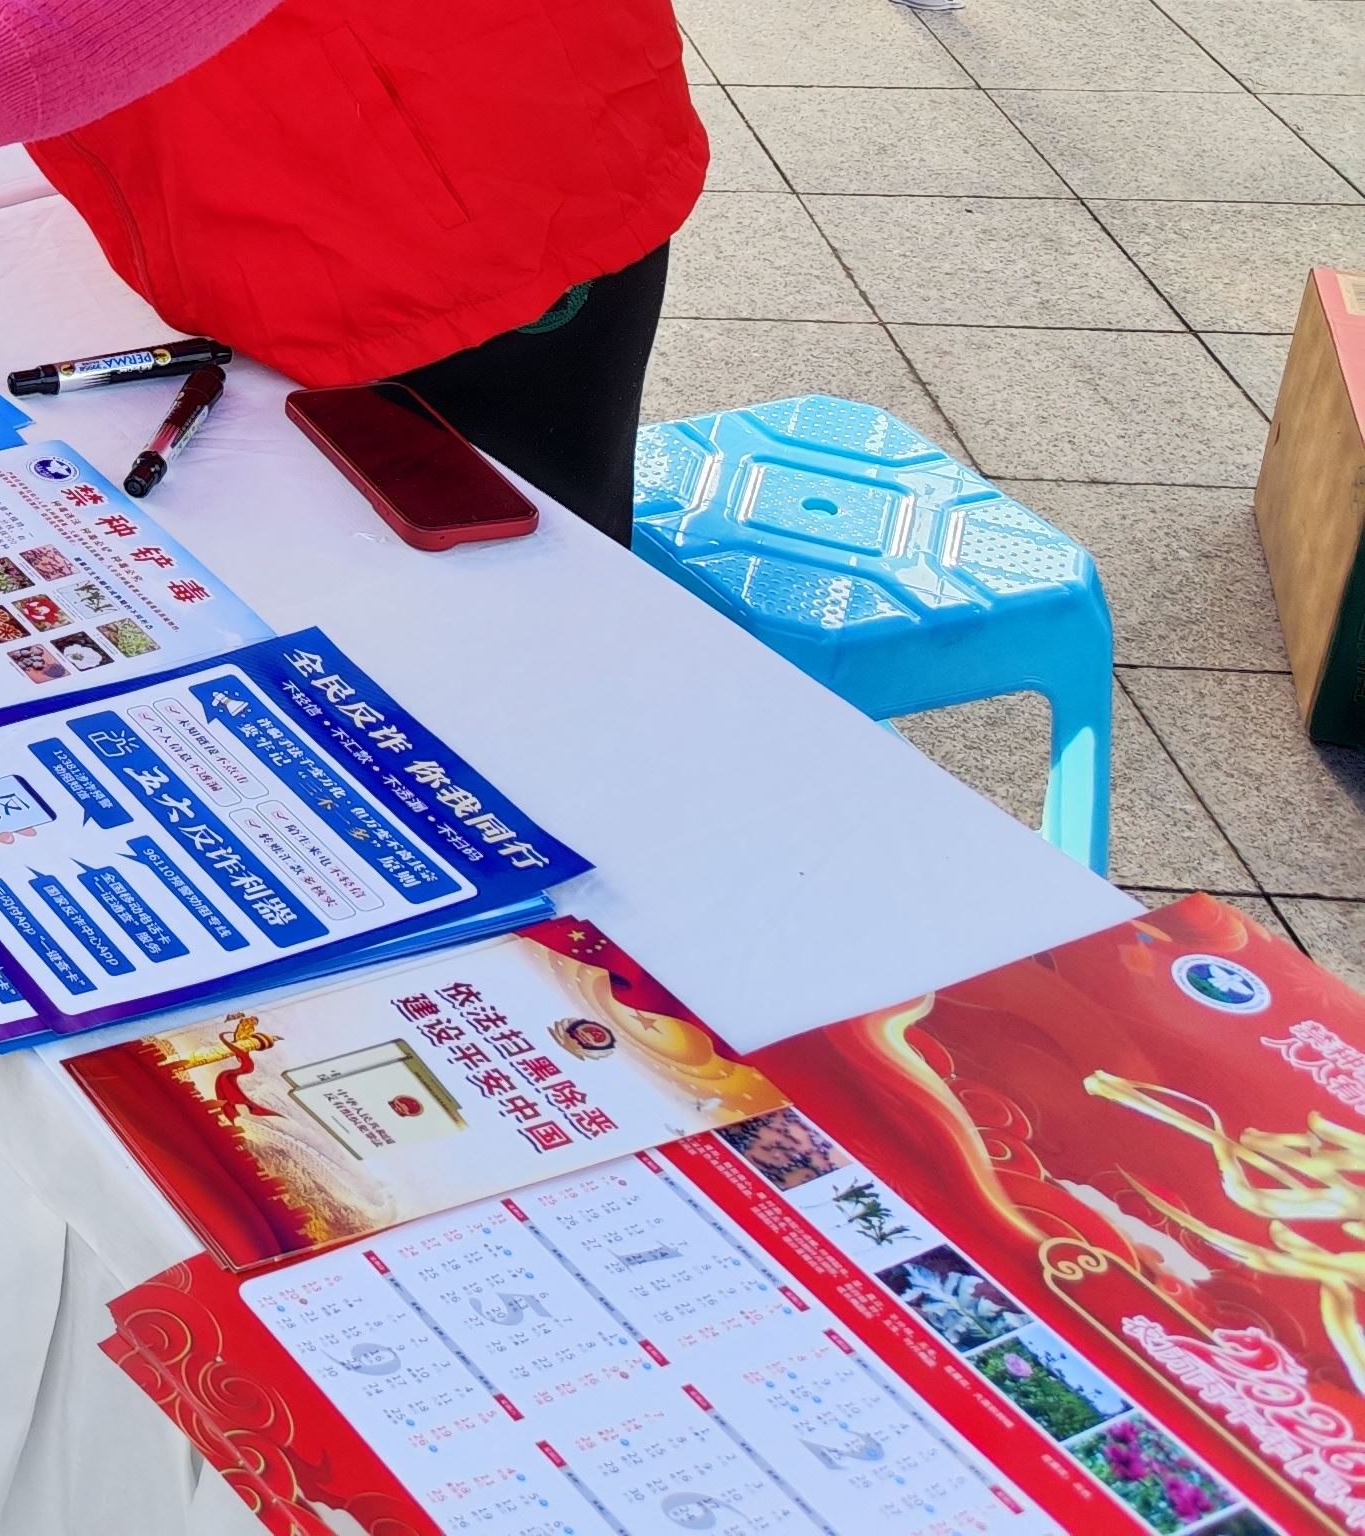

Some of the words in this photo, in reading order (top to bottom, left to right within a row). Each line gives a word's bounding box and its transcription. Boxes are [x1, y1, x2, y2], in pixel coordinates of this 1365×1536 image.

[102, 352, 152, 367] PERMA
[56, 483, 215, 605] 禁种铲毒
[47, 748, 119, 809] 12381涉诈预警
[145, 723, 228, 792] 个人信息不透漏
[171, 717, 254, 784] 未知链接不点击
[274, 679, 325, 717] 不轻信
[323, 726, 377, 764] 不汇款
[376, 774, 429, 812] 不透漏
[431, 823, 485, 862] 不扫码
[276, 645, 419, 755] 全民反诈
[398, 757, 554, 873] 你我同行
[119, 761, 305, 928] 五大反诈利器
[233, 722, 294, 768] 要牢记
[374, 853, 422, 889] 原则
[138, 847, 237, 938] 96110预警劝阻专线
[252, 831, 344, 909] 转账汇款多核实
[280, 823, 371, 899] 陌生来电不轻信
[38, 884, 126, 967] 国家反诈中心App
[94, 871, 179, 945] 全国移动电话卡
[132, 929, 167, 955] 服务
[389, 992, 576, 1152] 建设平安中国
[433, 980, 624, 1138] 依法扫黑除恶
